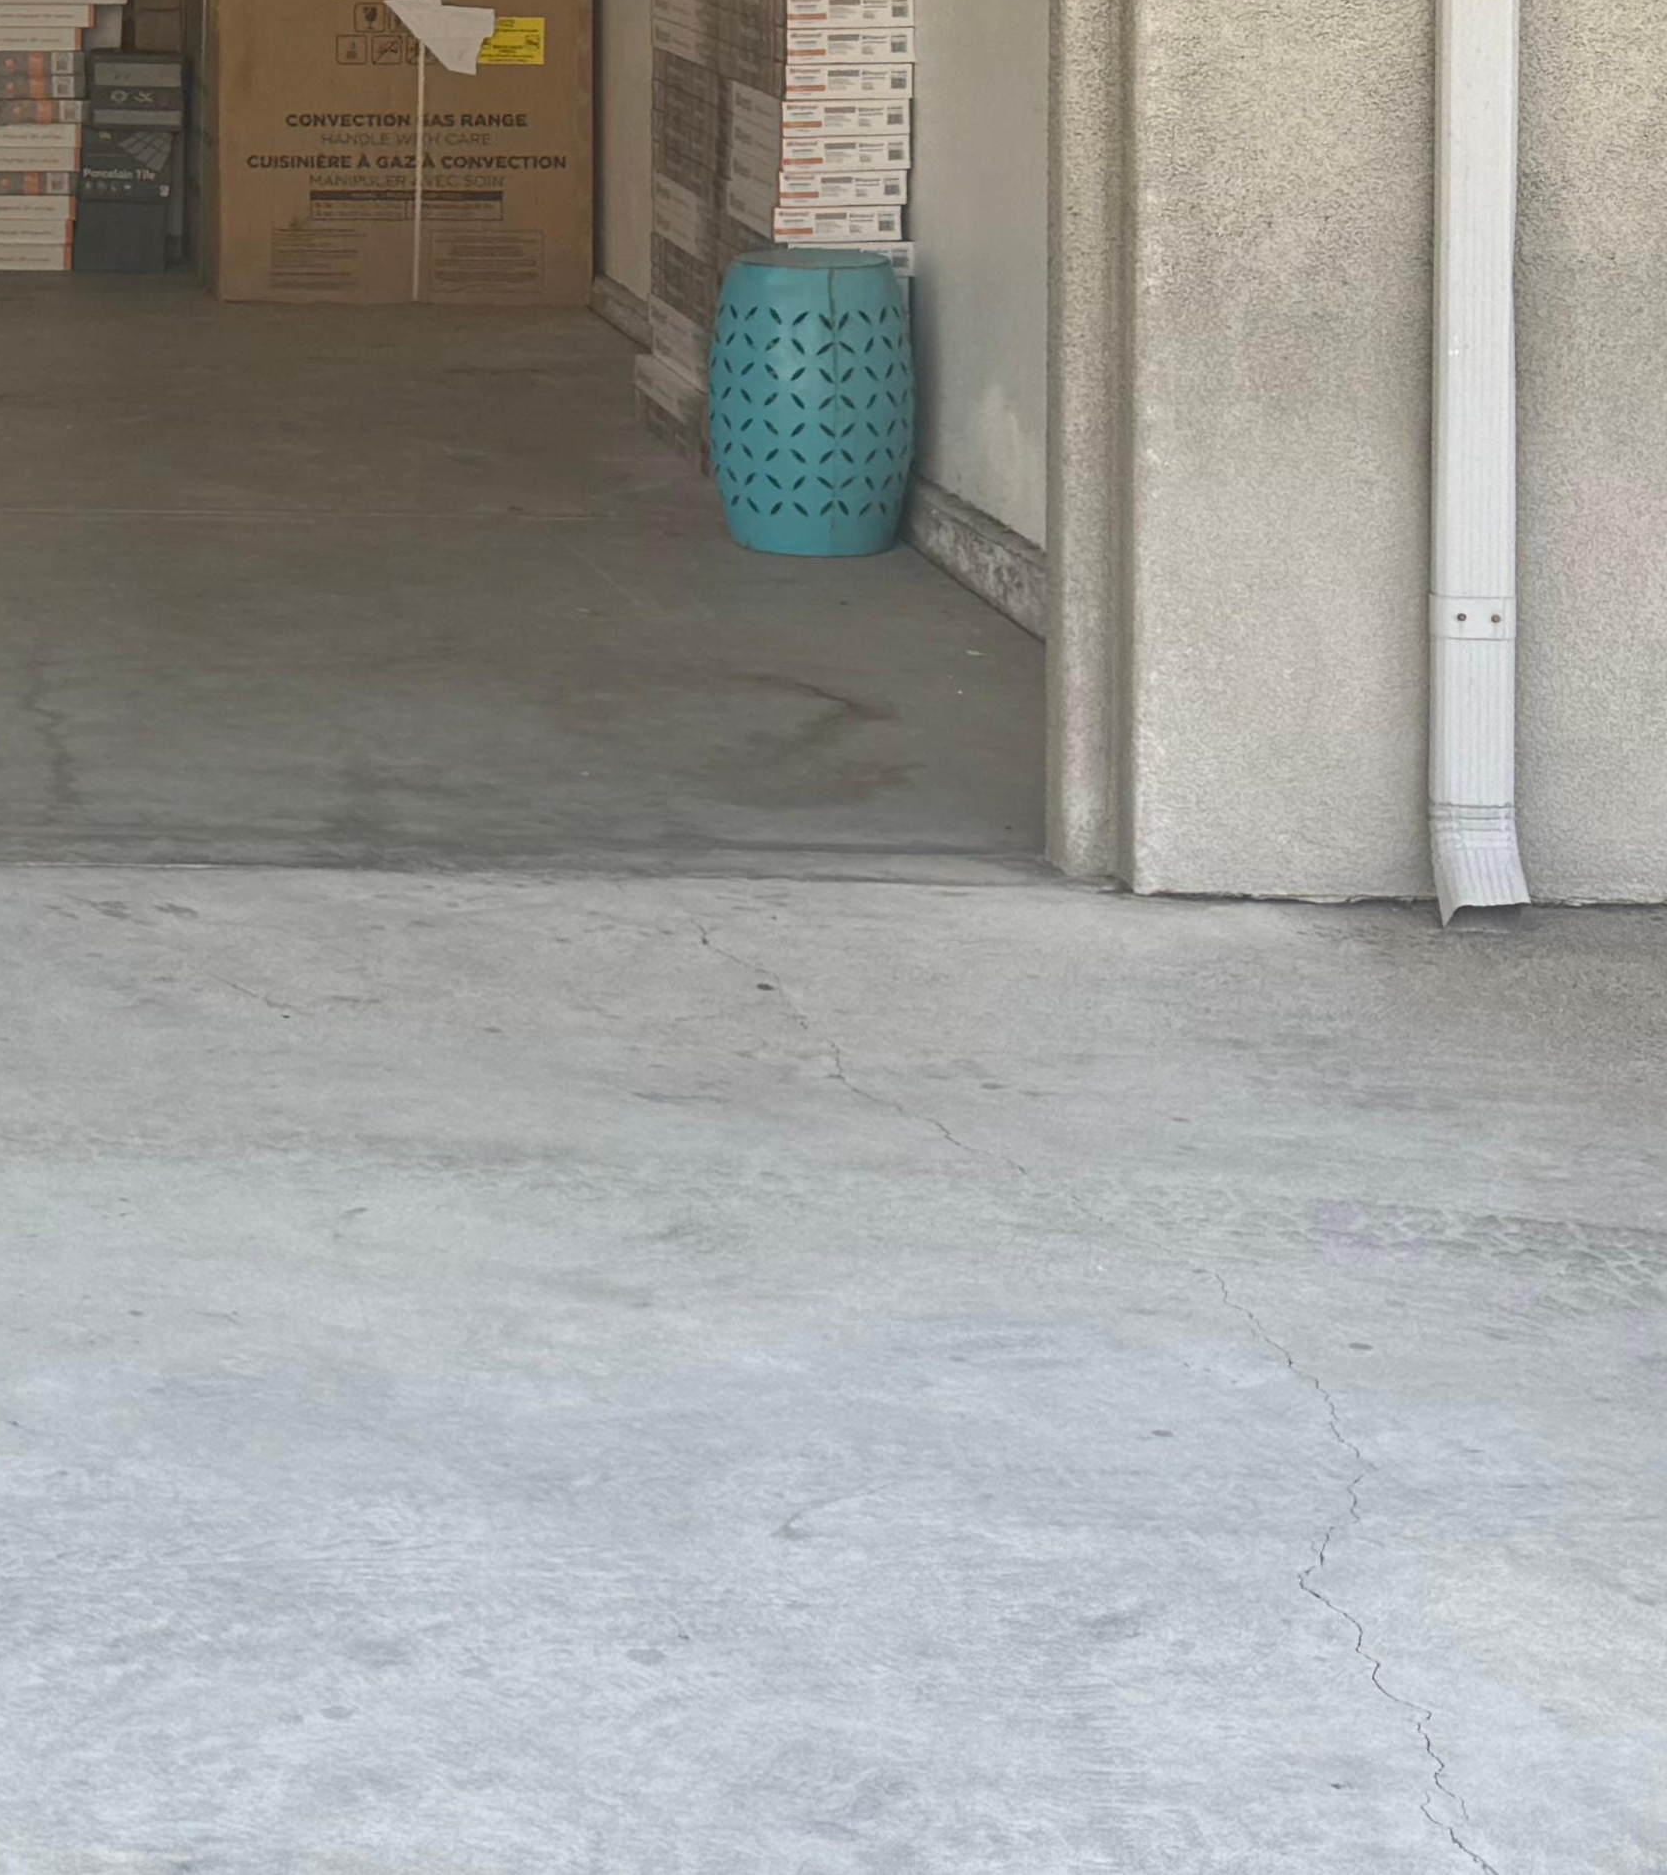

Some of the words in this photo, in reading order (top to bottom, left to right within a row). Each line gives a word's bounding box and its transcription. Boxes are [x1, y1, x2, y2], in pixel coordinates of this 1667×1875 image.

[285, 113, 410, 127] CONVECTION
[460, 113, 528, 127] RANGE
[320, 133, 393, 146] HANDLE
[444, 133, 492, 146] CARE
[247, 153, 351, 169] CUISINIÈRE
[376, 155, 416, 169] GAZ
[441, 155, 567, 170] CONVECTION
[83, 167, 133, 180] Porcelain
[136, 168, 157, 181] Tile
[465, 174, 505, 188] SOIN
